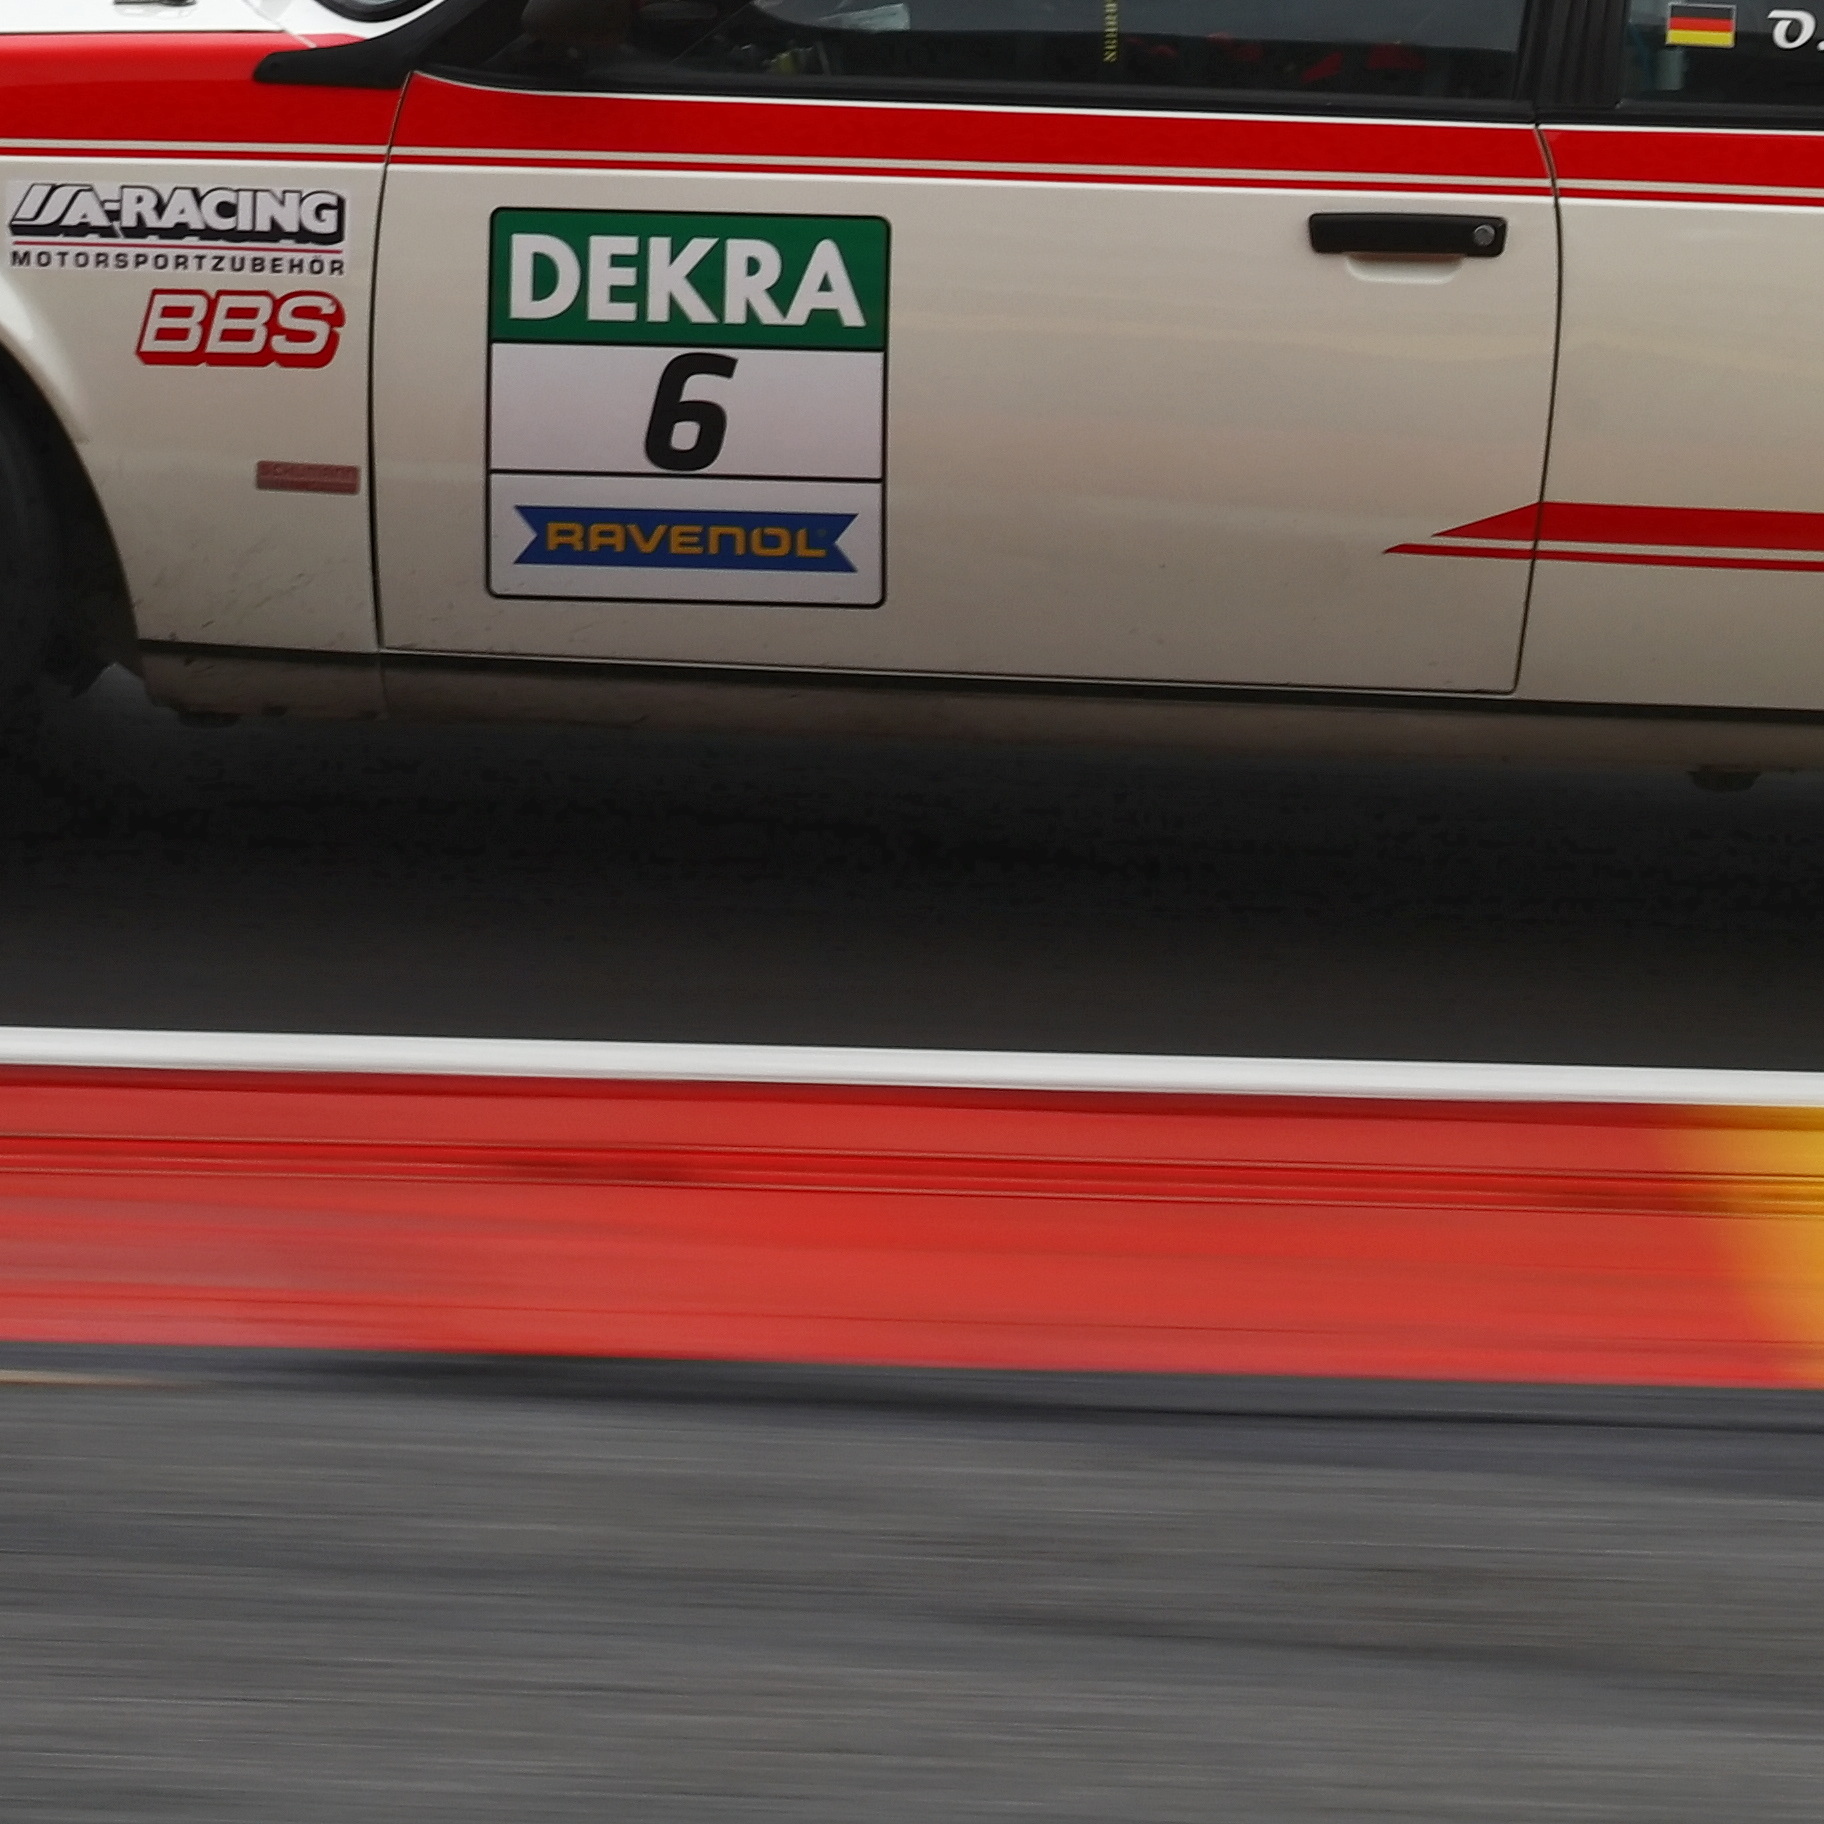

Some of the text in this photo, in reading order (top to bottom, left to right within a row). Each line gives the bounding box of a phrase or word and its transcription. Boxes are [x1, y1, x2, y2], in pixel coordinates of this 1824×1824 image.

[10, 250, 345, 277] MOTORSPORTZUBEHÖR
[508, 232, 867, 328] DEKRA
[135, 288, 347, 368] BBS
[644, 351, 739, 473] 6
[545, 520, 828, 559] RAVENOL
